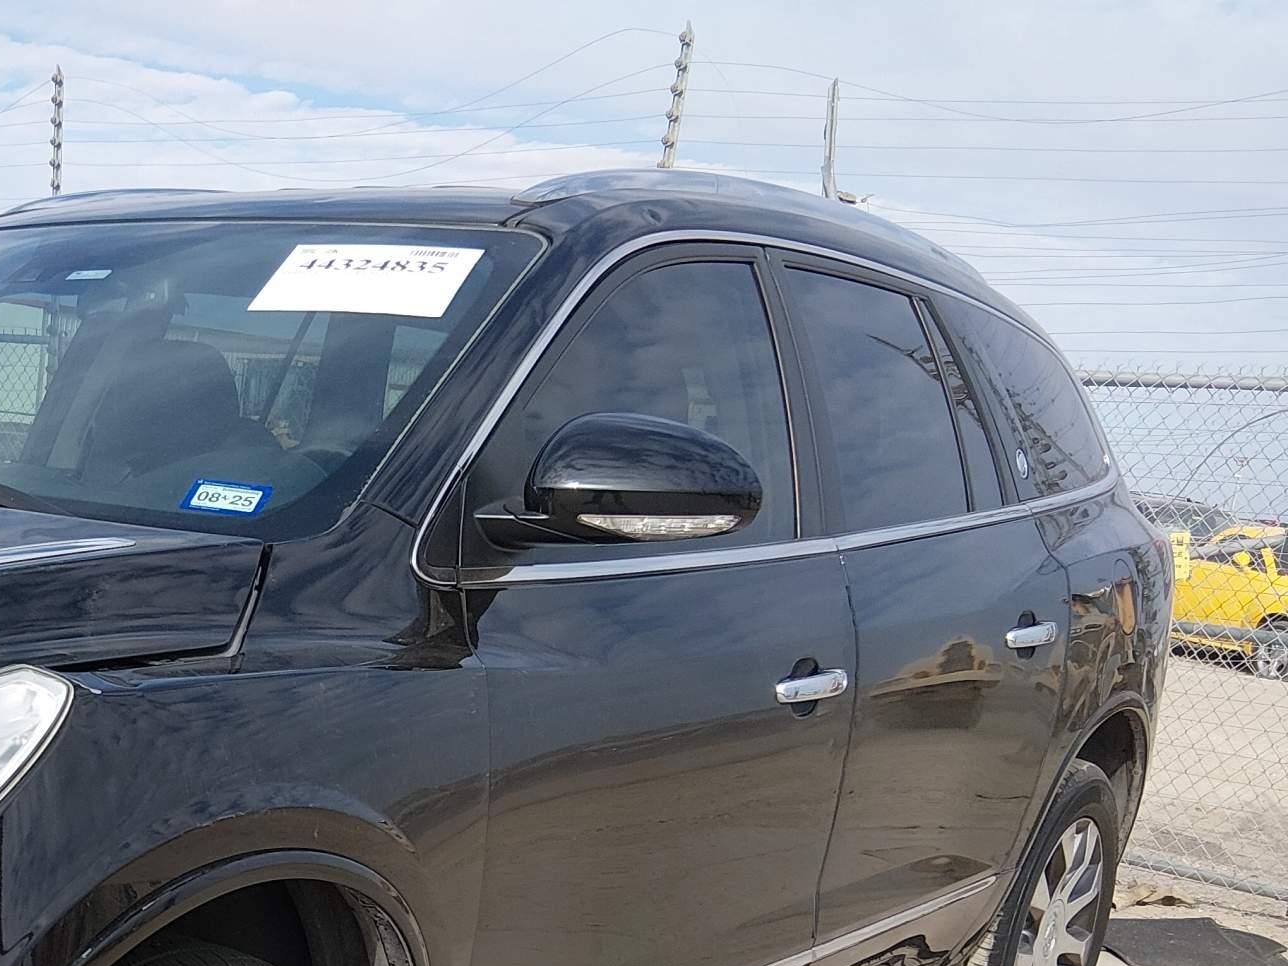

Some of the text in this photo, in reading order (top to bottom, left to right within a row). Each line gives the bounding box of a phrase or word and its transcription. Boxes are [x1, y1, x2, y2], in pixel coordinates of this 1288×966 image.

[298, 257, 449, 275] 44324835
[197, 490, 222, 503] 08
[229, 494, 256, 507] 25
